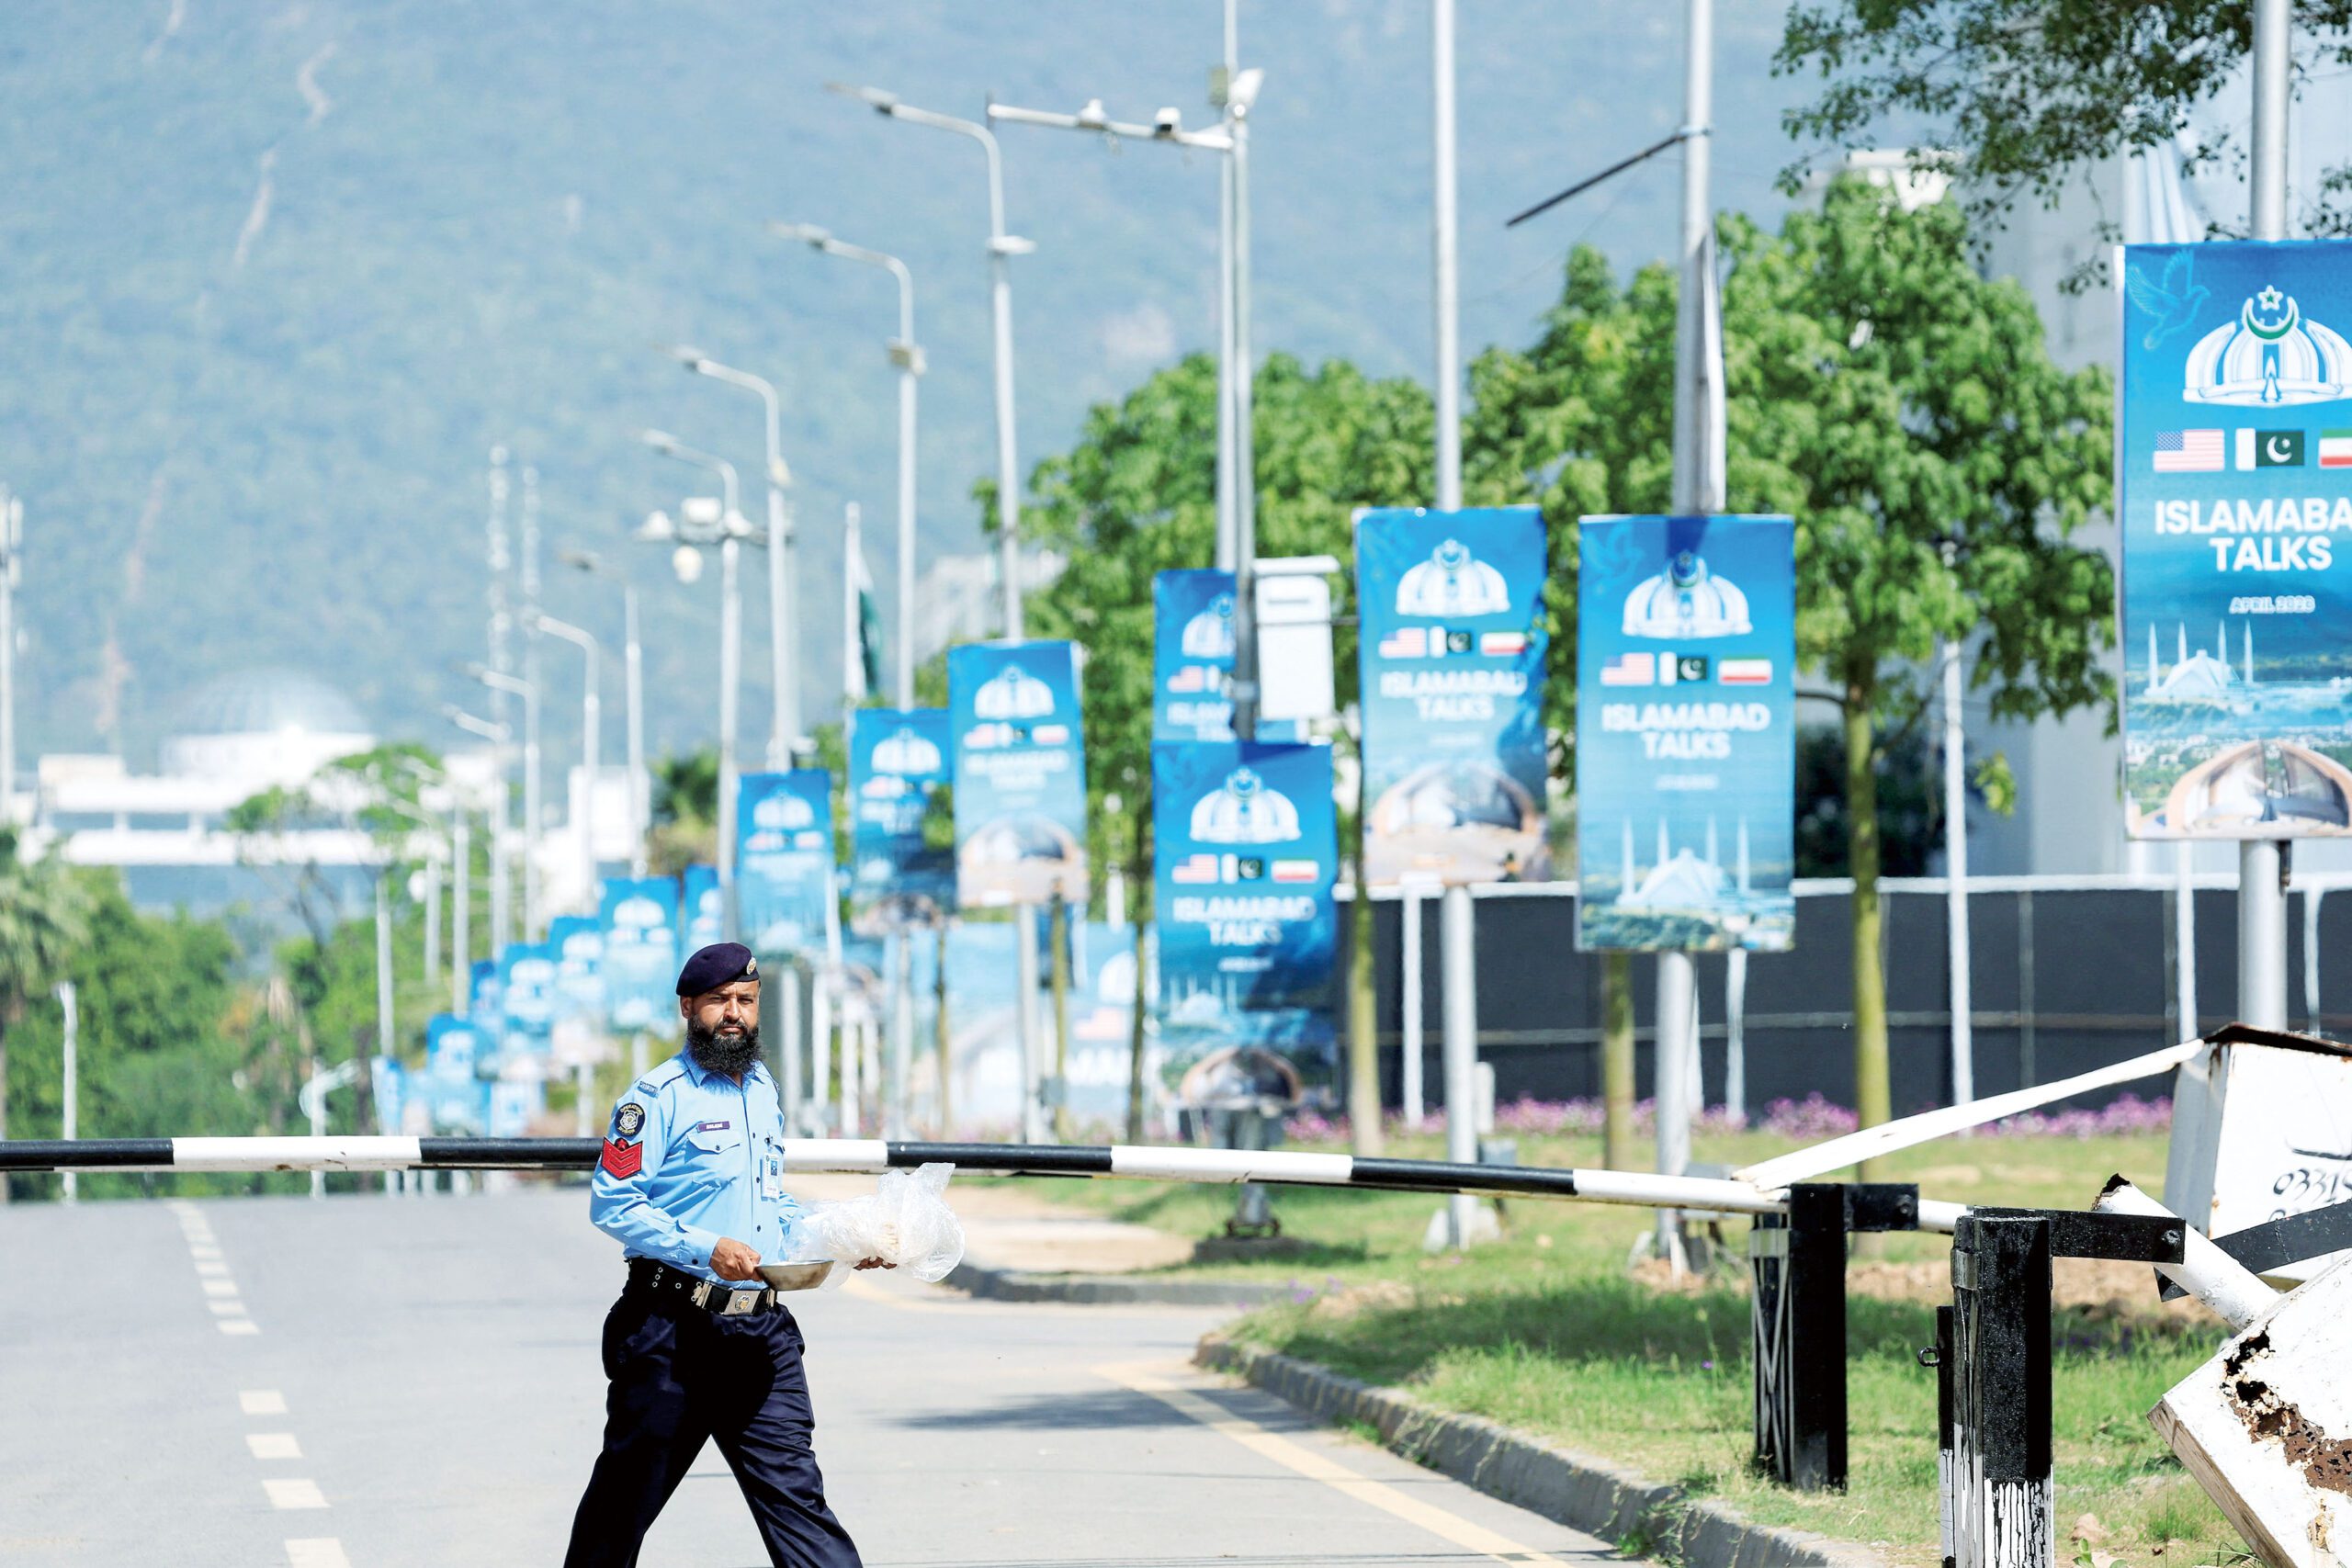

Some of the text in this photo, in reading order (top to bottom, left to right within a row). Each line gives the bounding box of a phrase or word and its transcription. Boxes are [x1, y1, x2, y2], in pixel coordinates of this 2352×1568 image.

[2154, 497, 2352, 534] ISLAMABA
[2209, 536, 2333, 572] TALKS
[2229, 597, 2274, 614] APRIL
[1601, 703, 1770, 732] ISLAMABAD
[1640, 732, 1731, 760] TALKS
